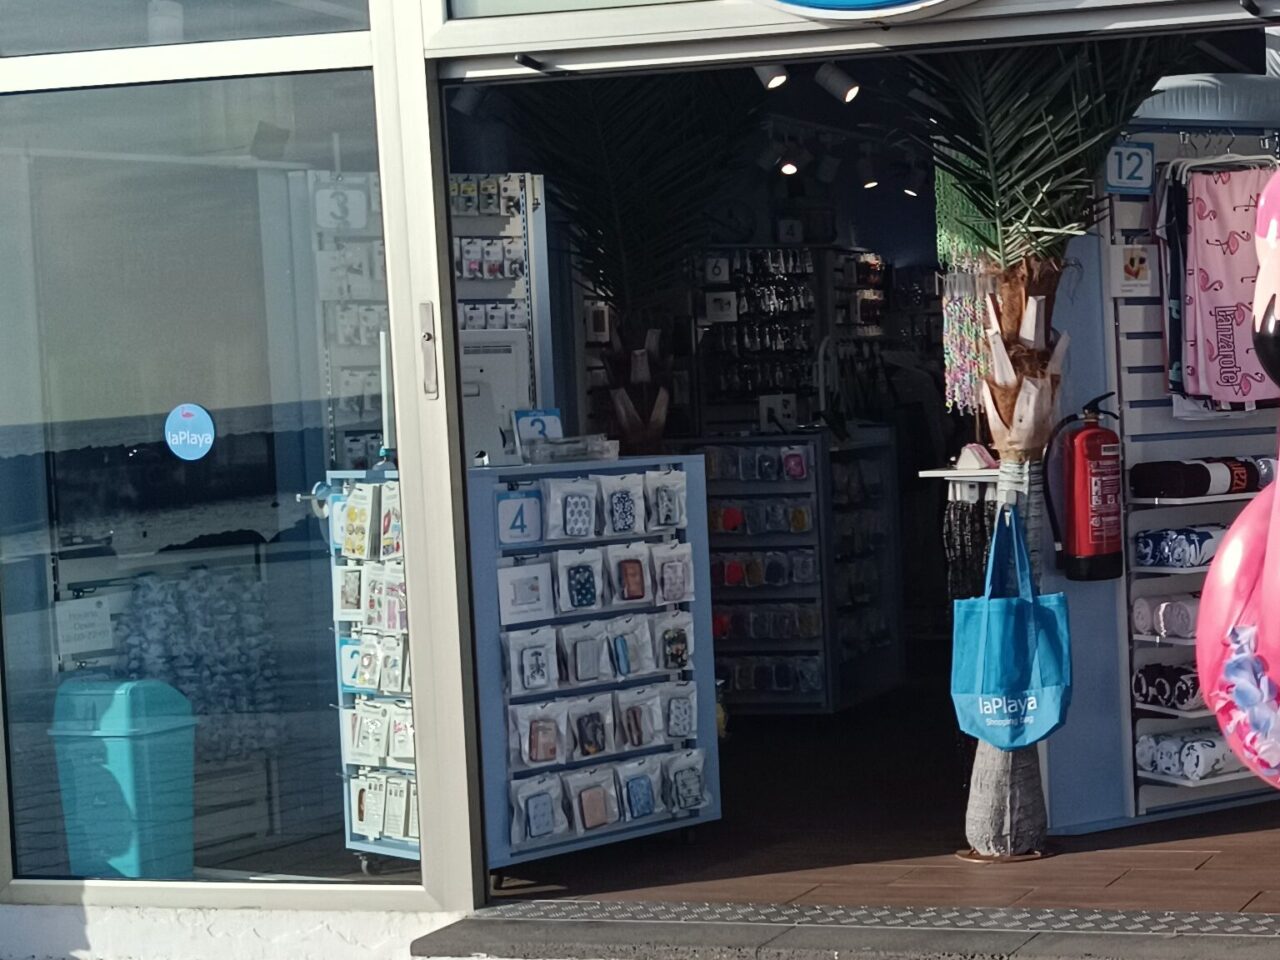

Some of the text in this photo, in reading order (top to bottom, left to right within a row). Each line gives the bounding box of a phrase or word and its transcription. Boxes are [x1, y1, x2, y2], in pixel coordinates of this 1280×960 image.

[1114, 151, 1144, 181] 12
[329, 191, 349, 221] 3
[711, 260, 722, 277] 6
[1214, 305, 1241, 387] Lanzarote
[167, 430, 213, 448] laPlaya
[509, 503, 528, 533] 4
[979, 696, 1037, 715] laPlaya
